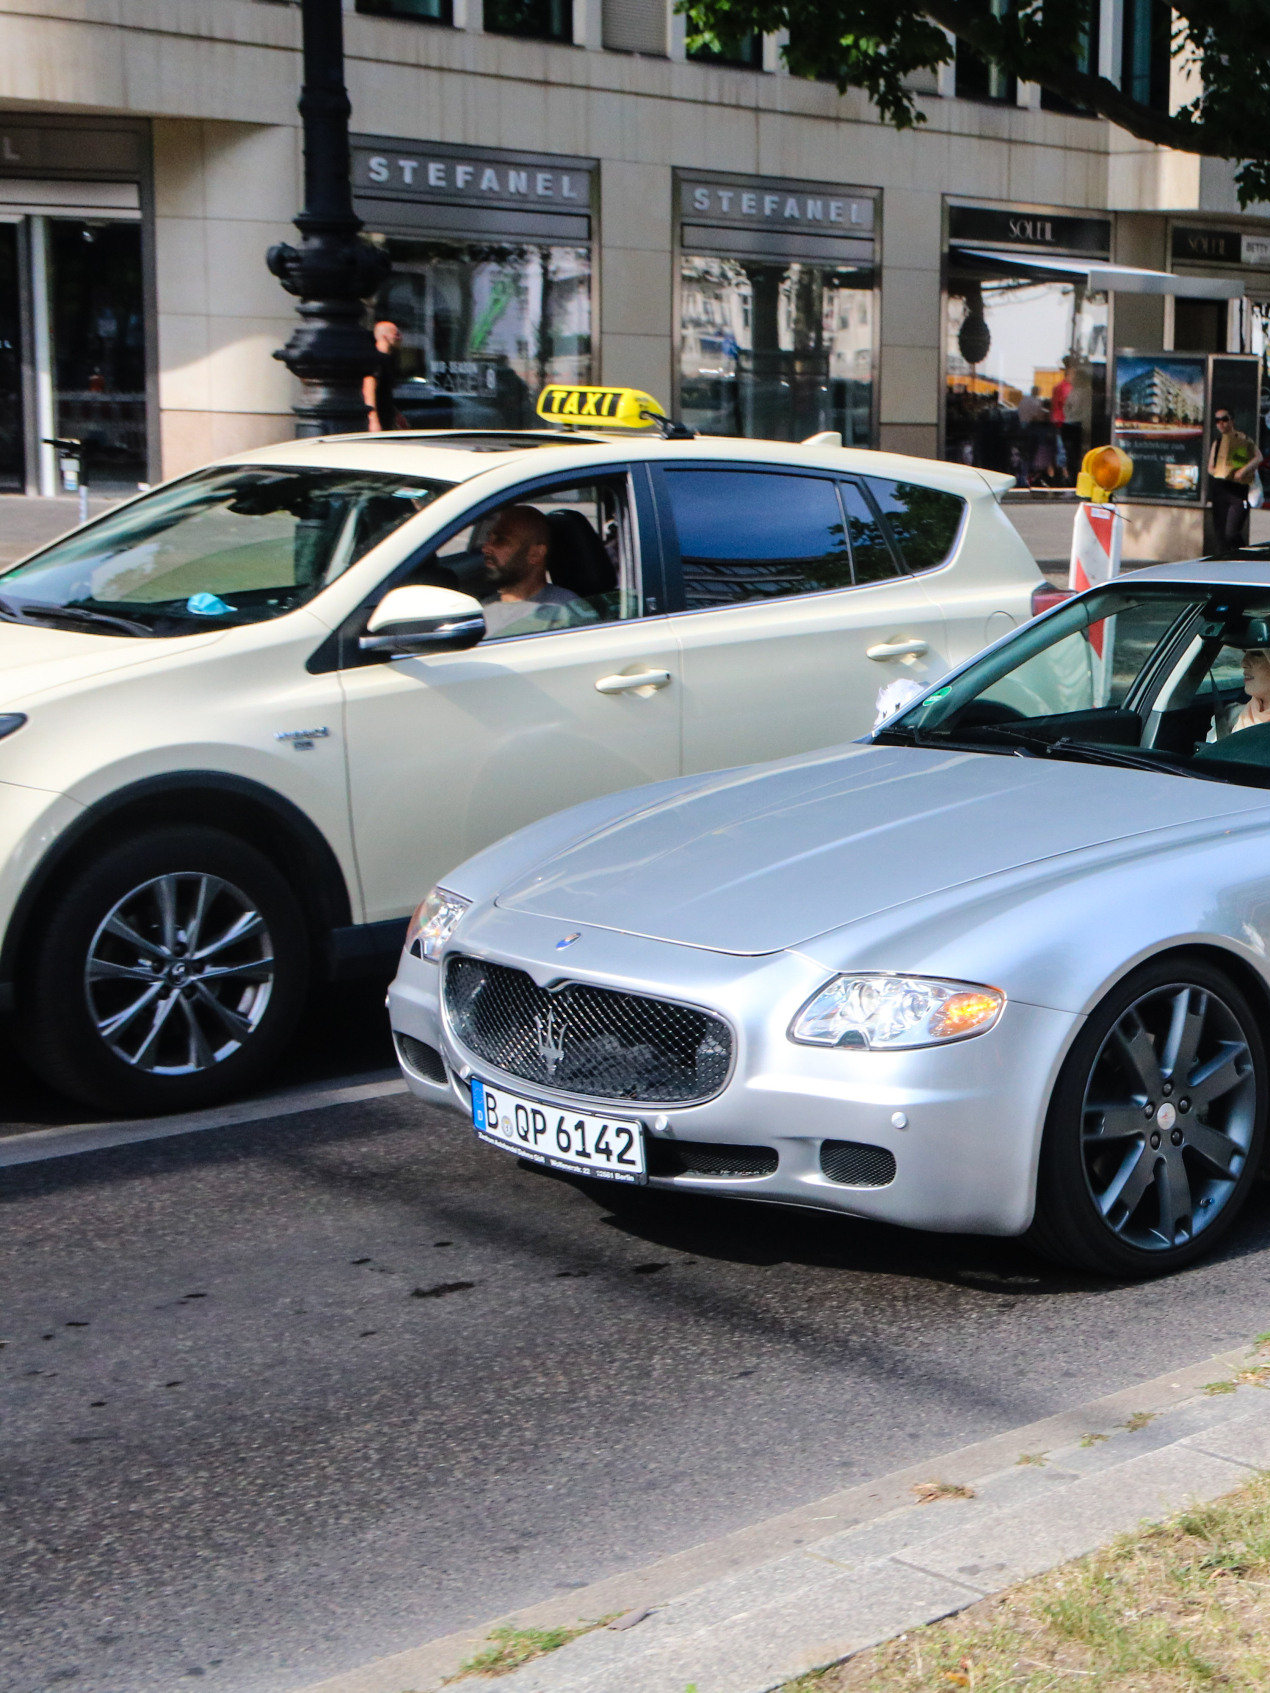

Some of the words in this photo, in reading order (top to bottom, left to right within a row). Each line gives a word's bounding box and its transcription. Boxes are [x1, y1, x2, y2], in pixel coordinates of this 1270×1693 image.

[369, 156, 578, 199] STEFANEL
[693, 187, 862, 224] STEFANEL
[1246, 241, 1268, 253] BETTY
[551, 390, 614, 416] TAXI
[485, 1092, 499, 1130] B
[515, 1103, 547, 1146] QP
[556, 1116, 636, 1165] 6142
[614, 1172, 634, 1182] Berlin
